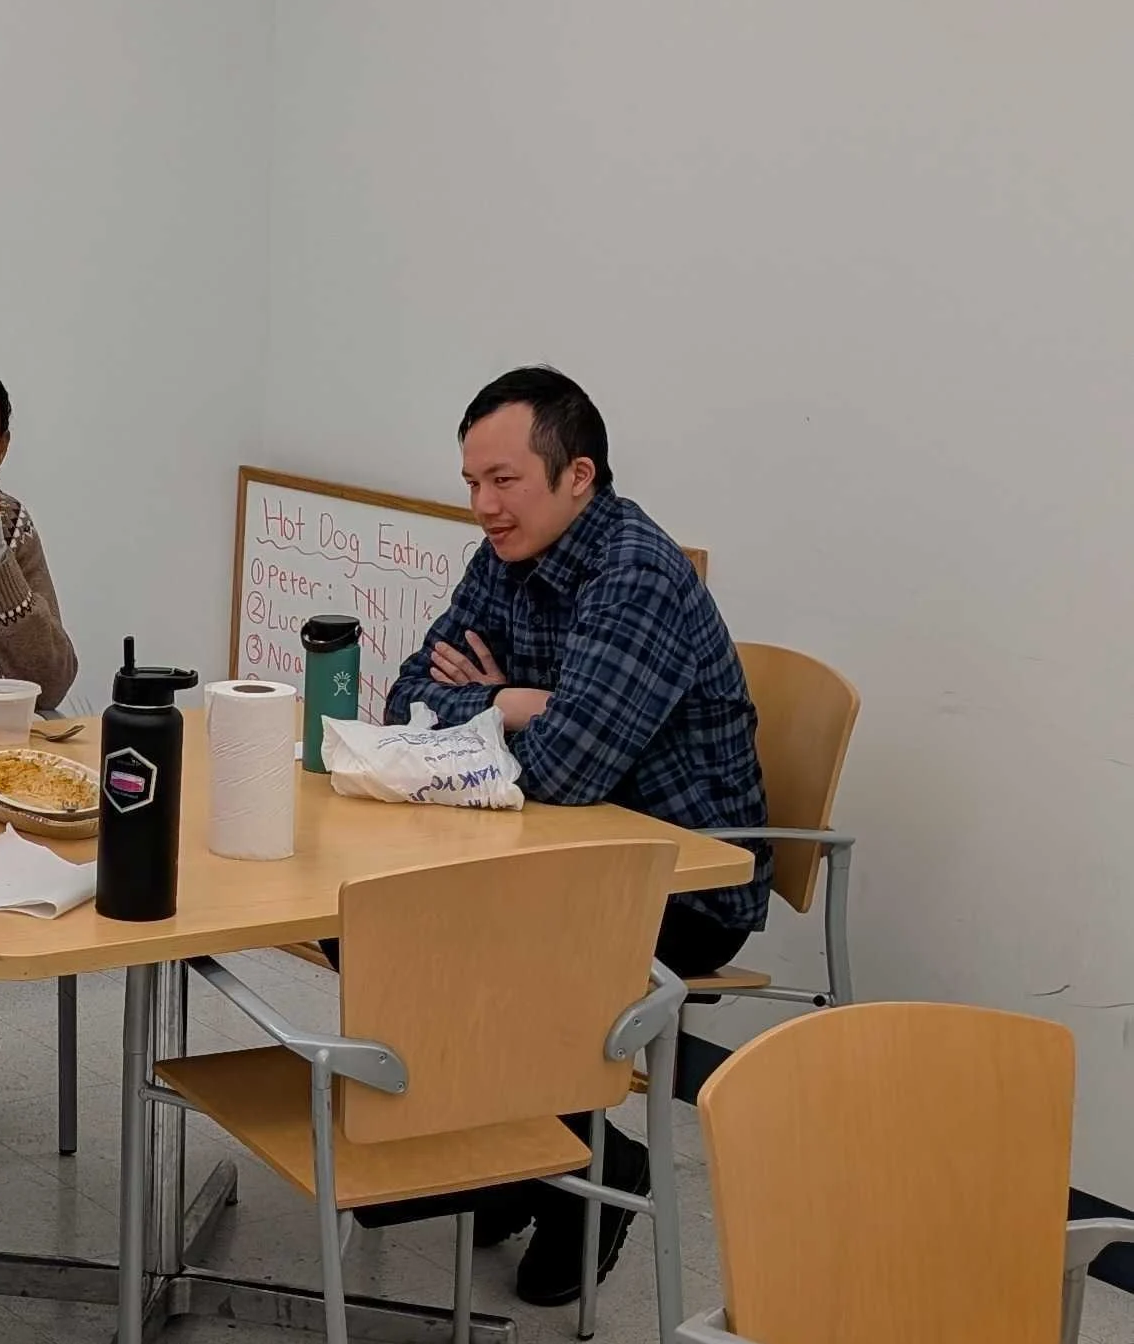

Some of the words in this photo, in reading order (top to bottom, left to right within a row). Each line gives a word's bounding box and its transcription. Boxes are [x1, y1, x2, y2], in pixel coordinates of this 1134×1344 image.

[263, 497, 305, 541] Hot
[319, 512, 361, 580] Dog
[377, 521, 450, 599] Eating
